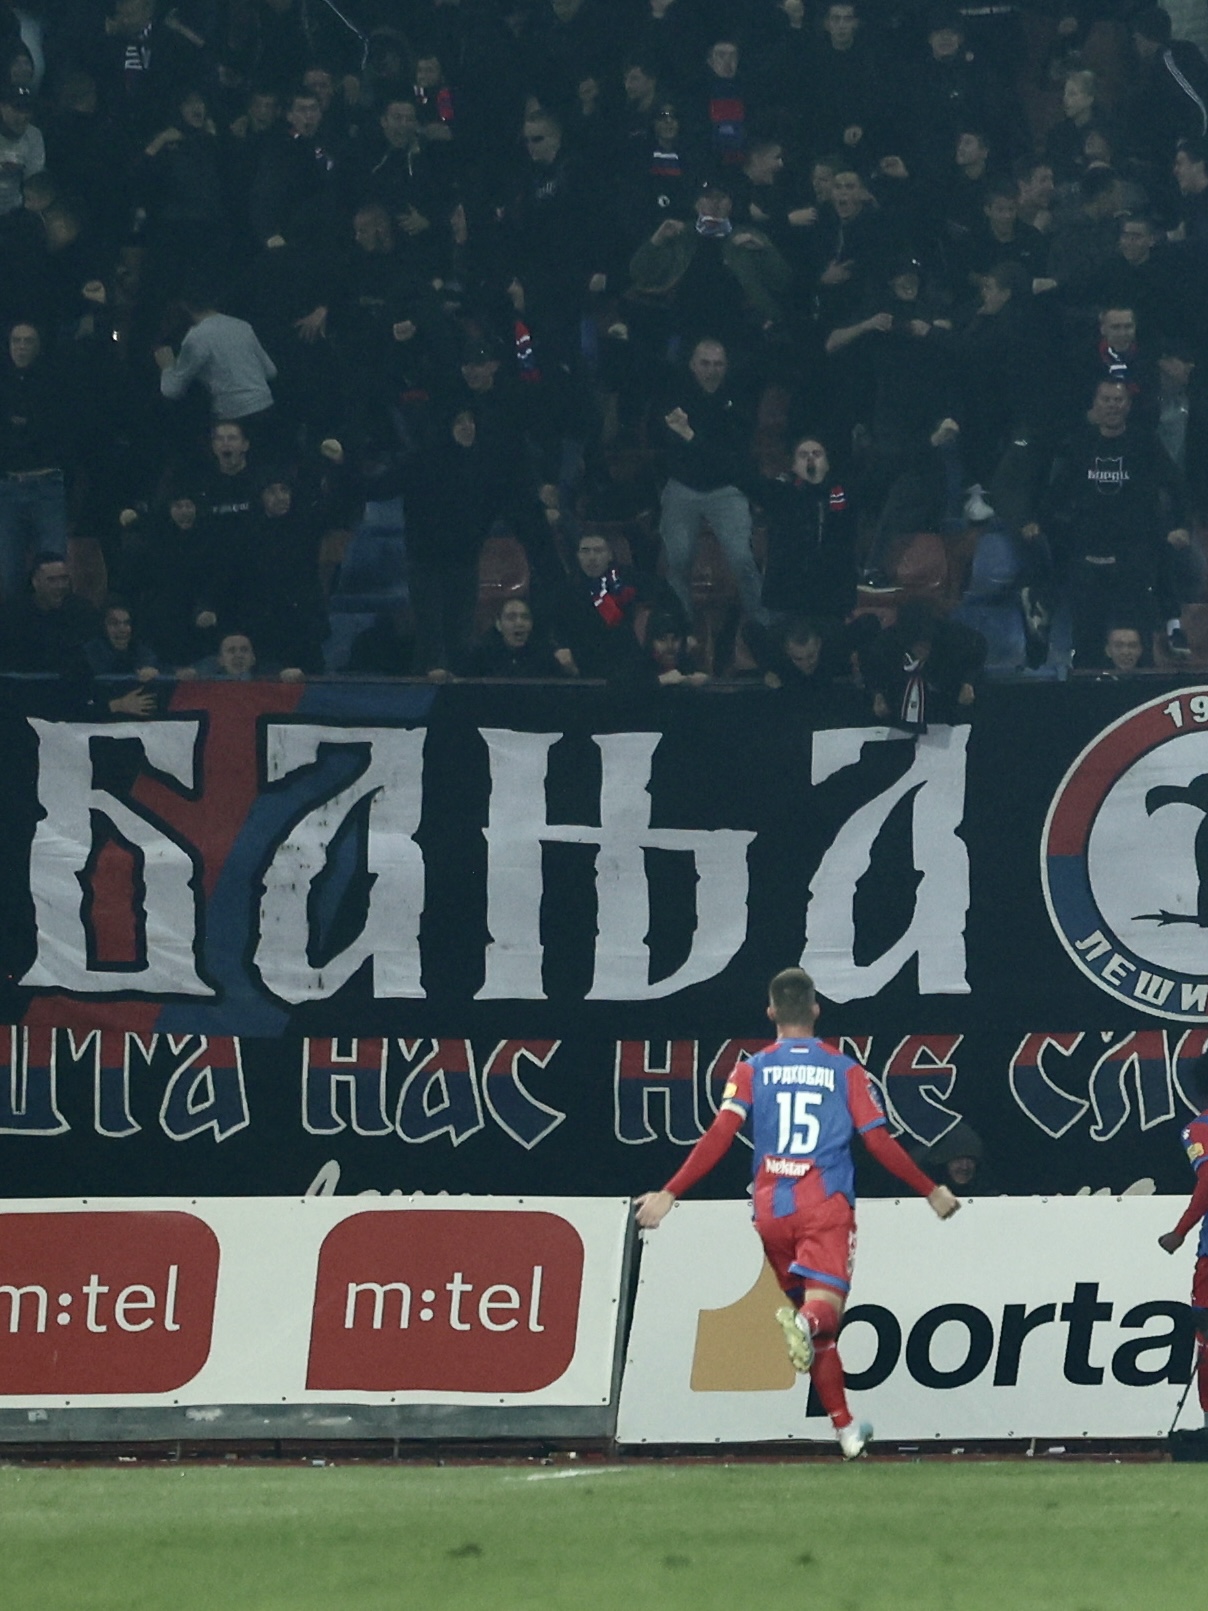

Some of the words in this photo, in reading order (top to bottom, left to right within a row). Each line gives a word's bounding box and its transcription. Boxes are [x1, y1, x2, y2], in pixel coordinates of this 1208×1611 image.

[776, 1091, 823, 1155] 15
[764, 1158, 811, 1177] Nektar
[0, 1265, 180, 1333] m:tel
[344, 1265, 546, 1333] m:tel
